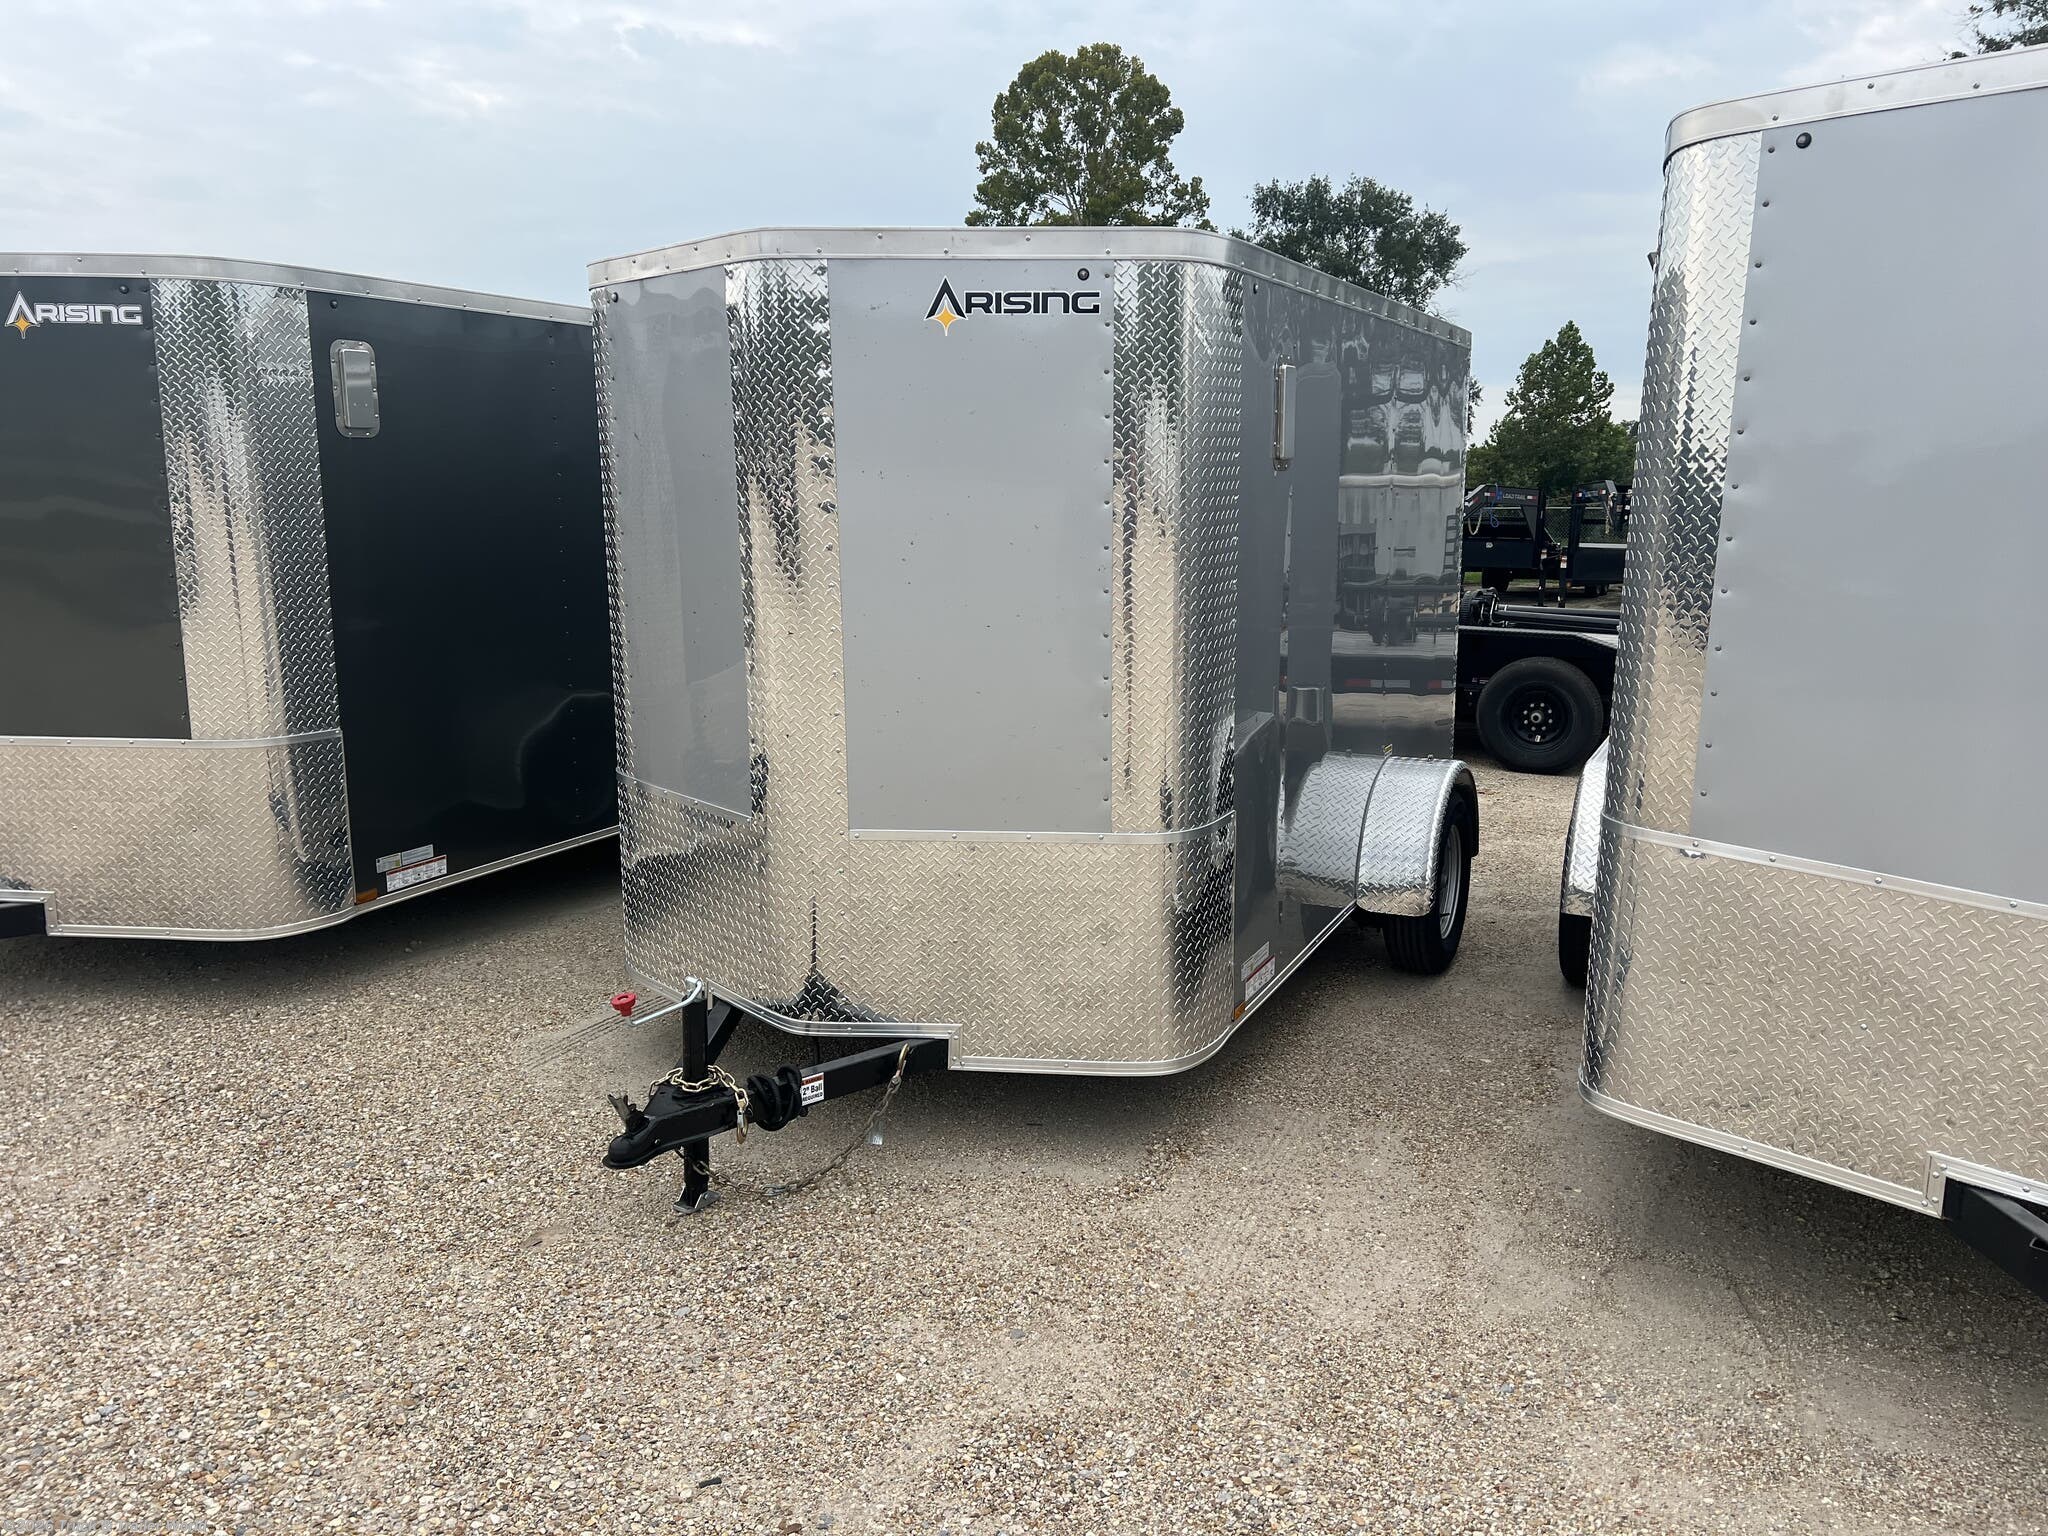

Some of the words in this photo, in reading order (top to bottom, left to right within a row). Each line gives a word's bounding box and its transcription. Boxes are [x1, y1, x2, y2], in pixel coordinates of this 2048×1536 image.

[5, 291, 142, 324] ARISING
[925, 276, 1100, 320] ARISING
[810, 1082, 823, 1094] Ball
